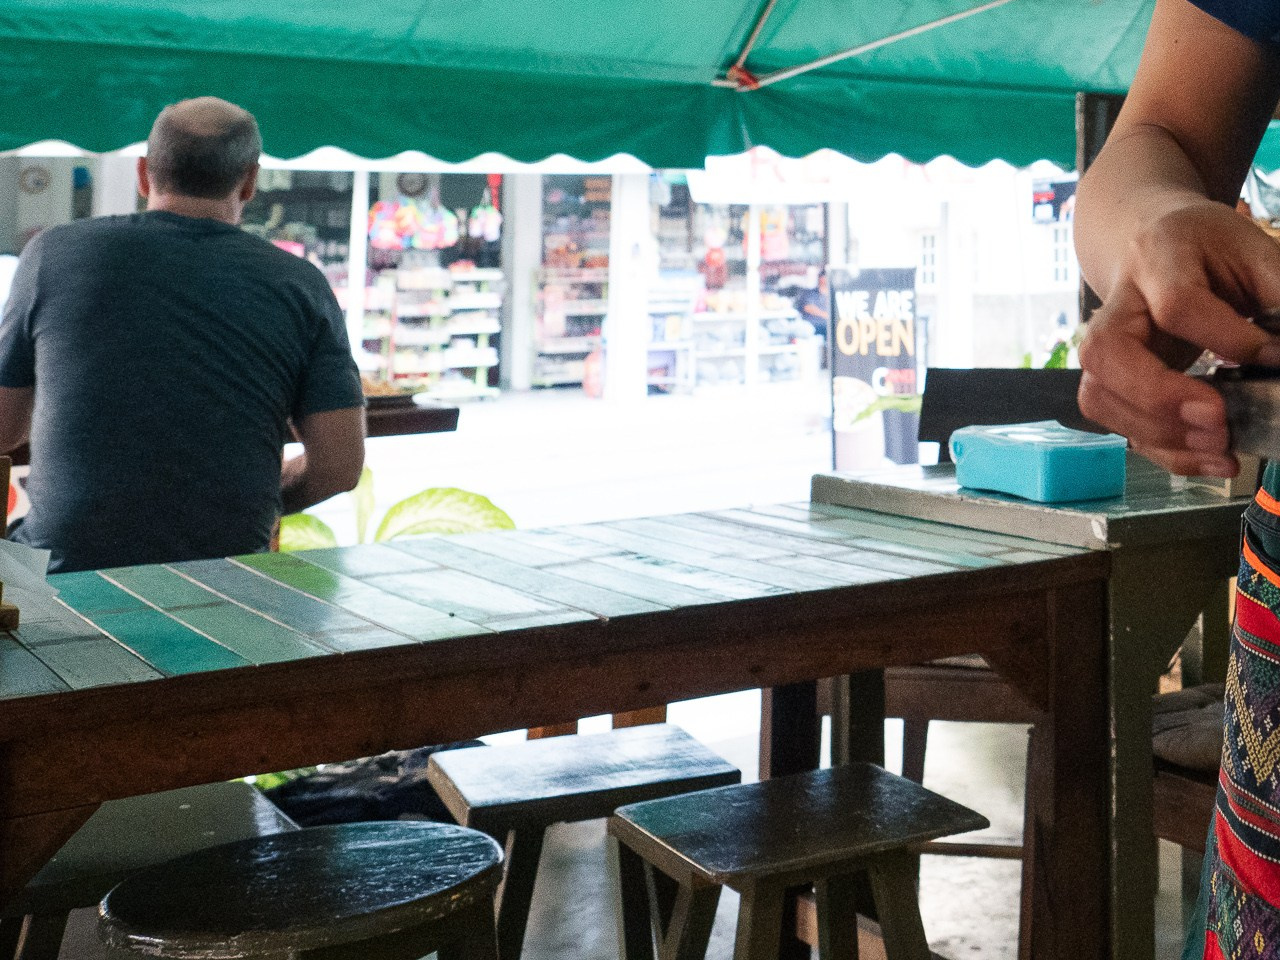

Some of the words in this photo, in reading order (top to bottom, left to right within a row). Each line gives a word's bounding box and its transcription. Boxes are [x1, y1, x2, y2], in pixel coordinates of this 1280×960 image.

[835, 290, 869, 319] WE
[873, 290, 914, 320] ARE
[836, 318, 914, 357] OPEN
